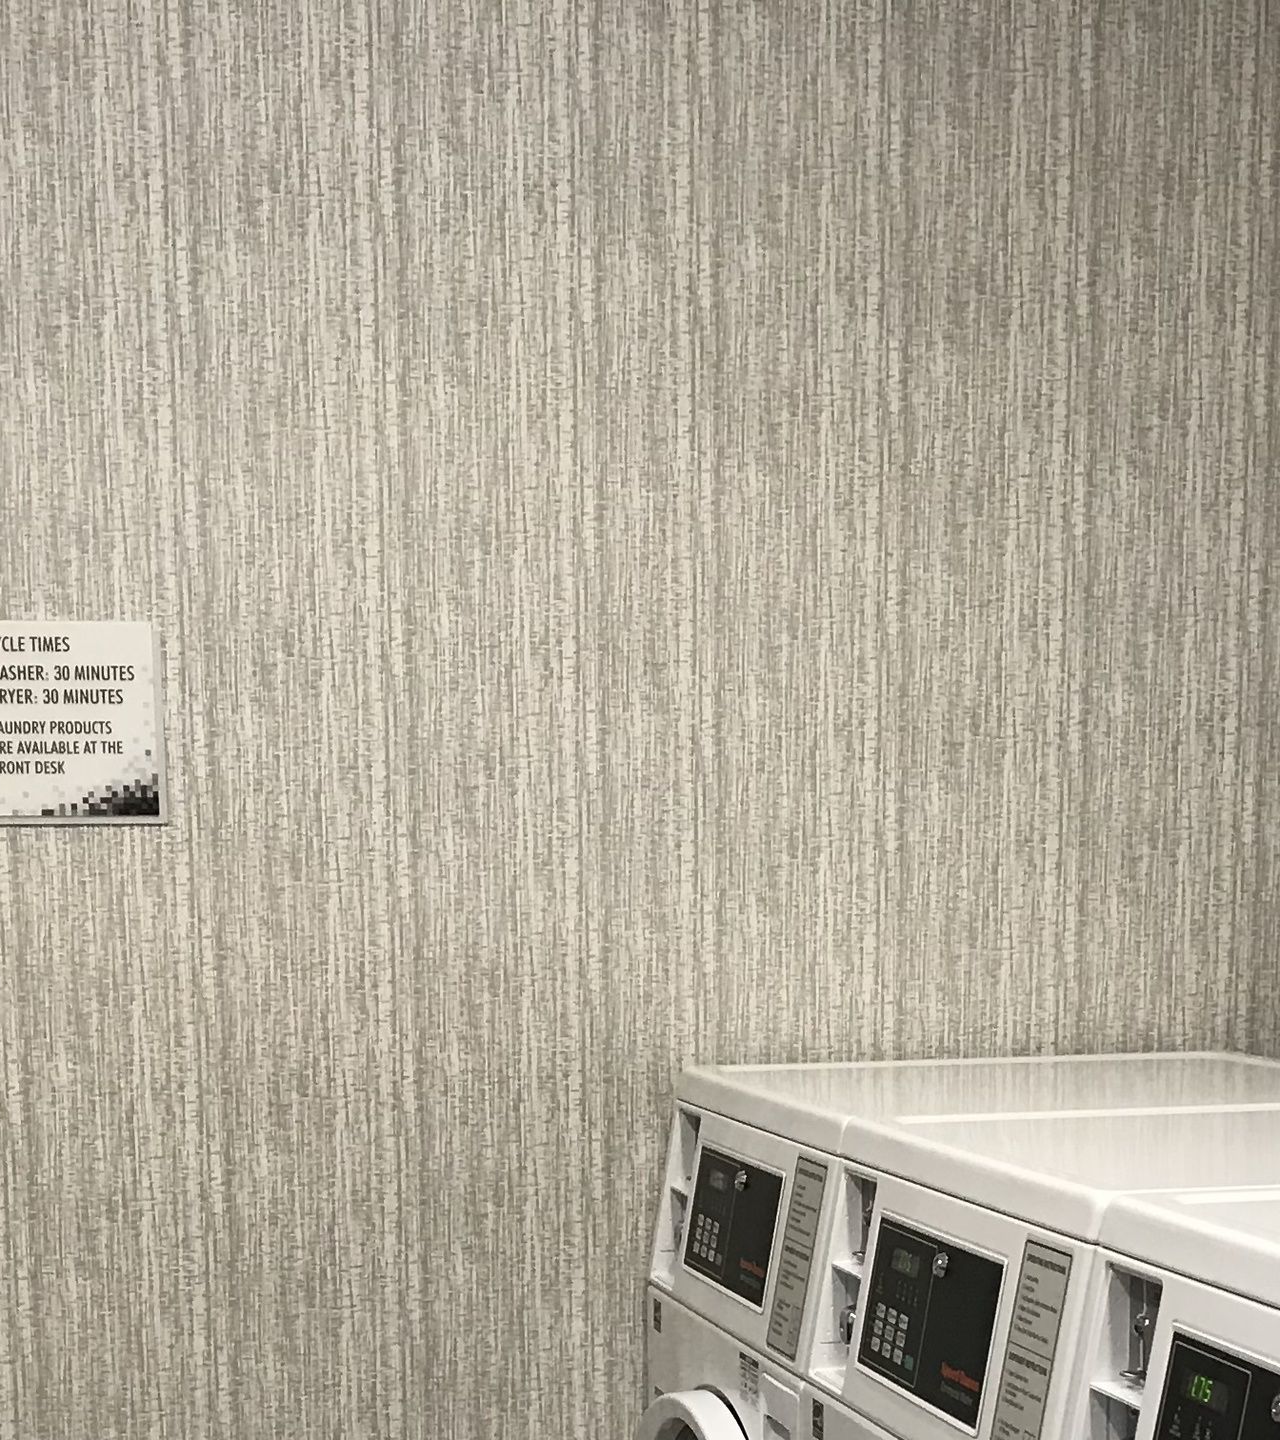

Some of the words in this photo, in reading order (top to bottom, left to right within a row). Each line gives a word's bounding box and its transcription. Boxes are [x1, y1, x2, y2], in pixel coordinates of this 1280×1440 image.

[29, 636, 71, 652] TIMES
[53, 665, 70, 681] 30
[74, 665, 135, 682] MINUTES
[42, 688, 59, 704] 30
[63, 689, 124, 705] MINUTES
[49, 721, 113, 735] PRODUCTS
[17, 741, 80, 755] AVAILABLE
[83, 741, 98, 755] AT
[100, 741, 124, 755] THE
[35, 761, 66, 775] DESK
